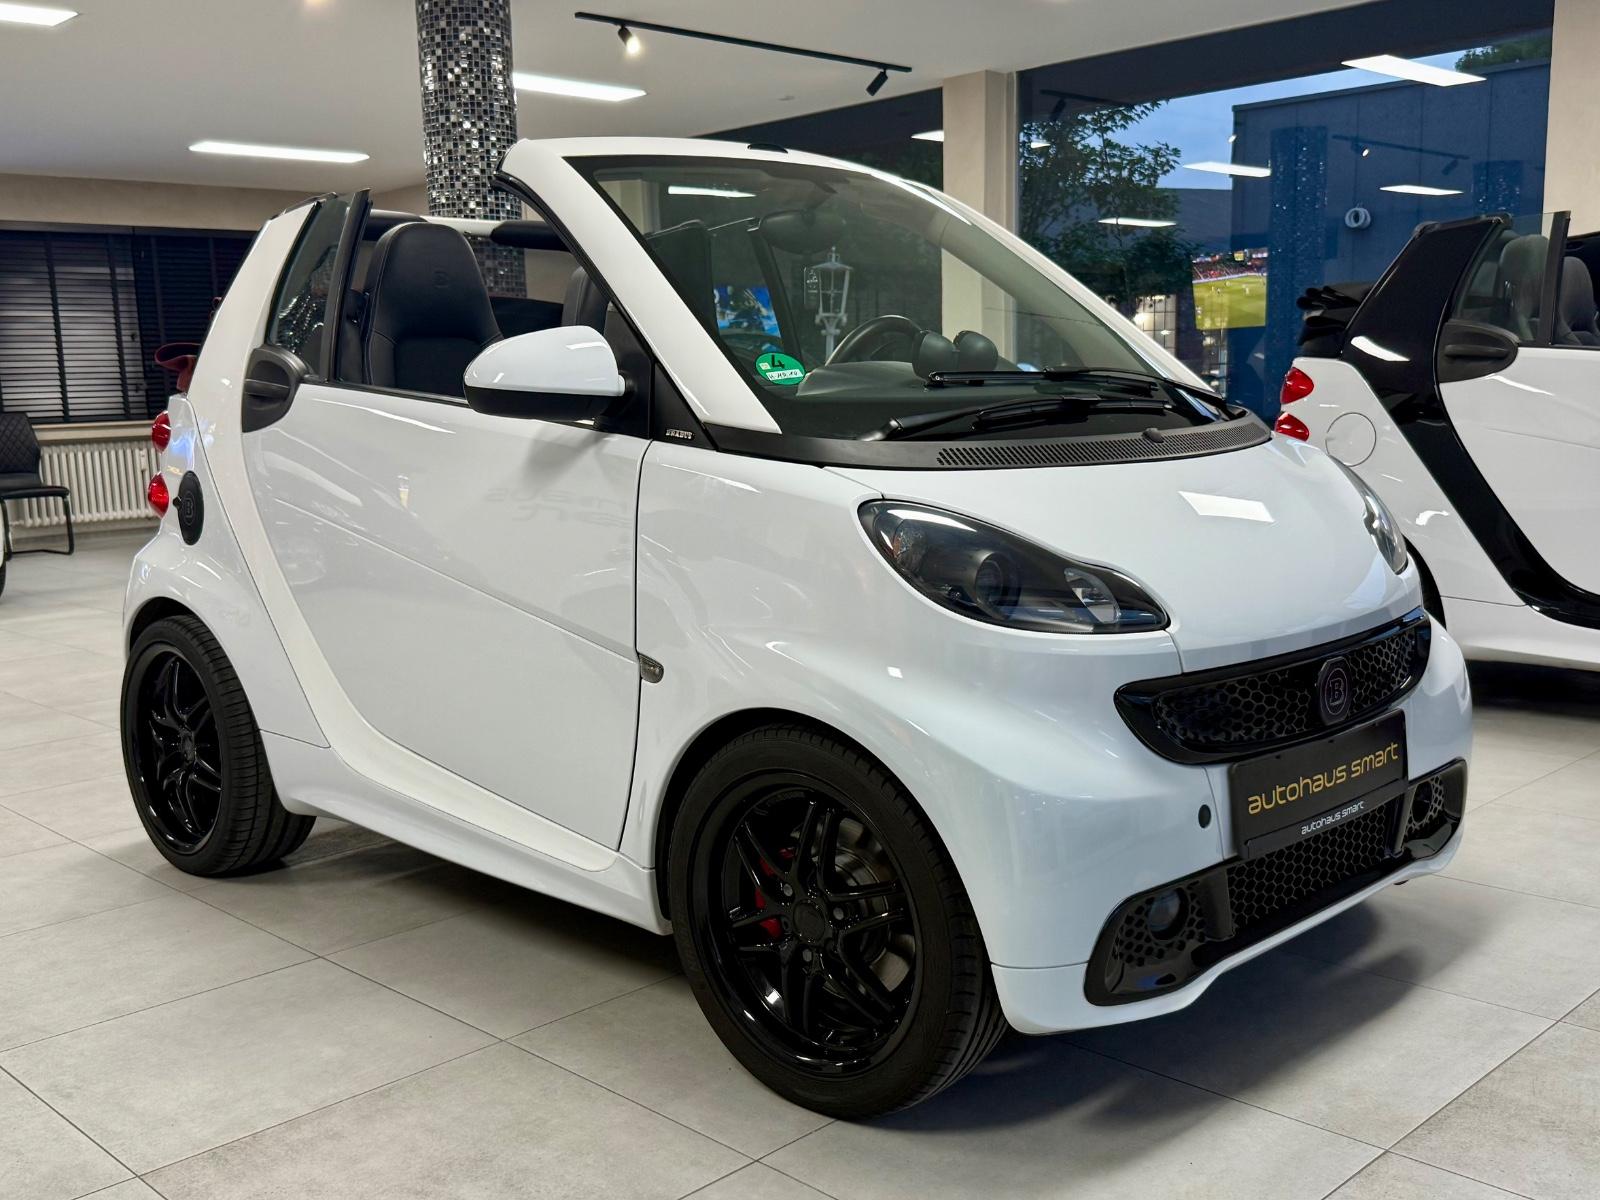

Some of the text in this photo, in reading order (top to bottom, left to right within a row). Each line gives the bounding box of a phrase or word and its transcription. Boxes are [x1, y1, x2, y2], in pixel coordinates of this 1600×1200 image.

[771, 354, 785, 369] 4
[1248, 742, 1399, 815] autohaus smart
[1301, 800, 1365, 835] autohaus smart
